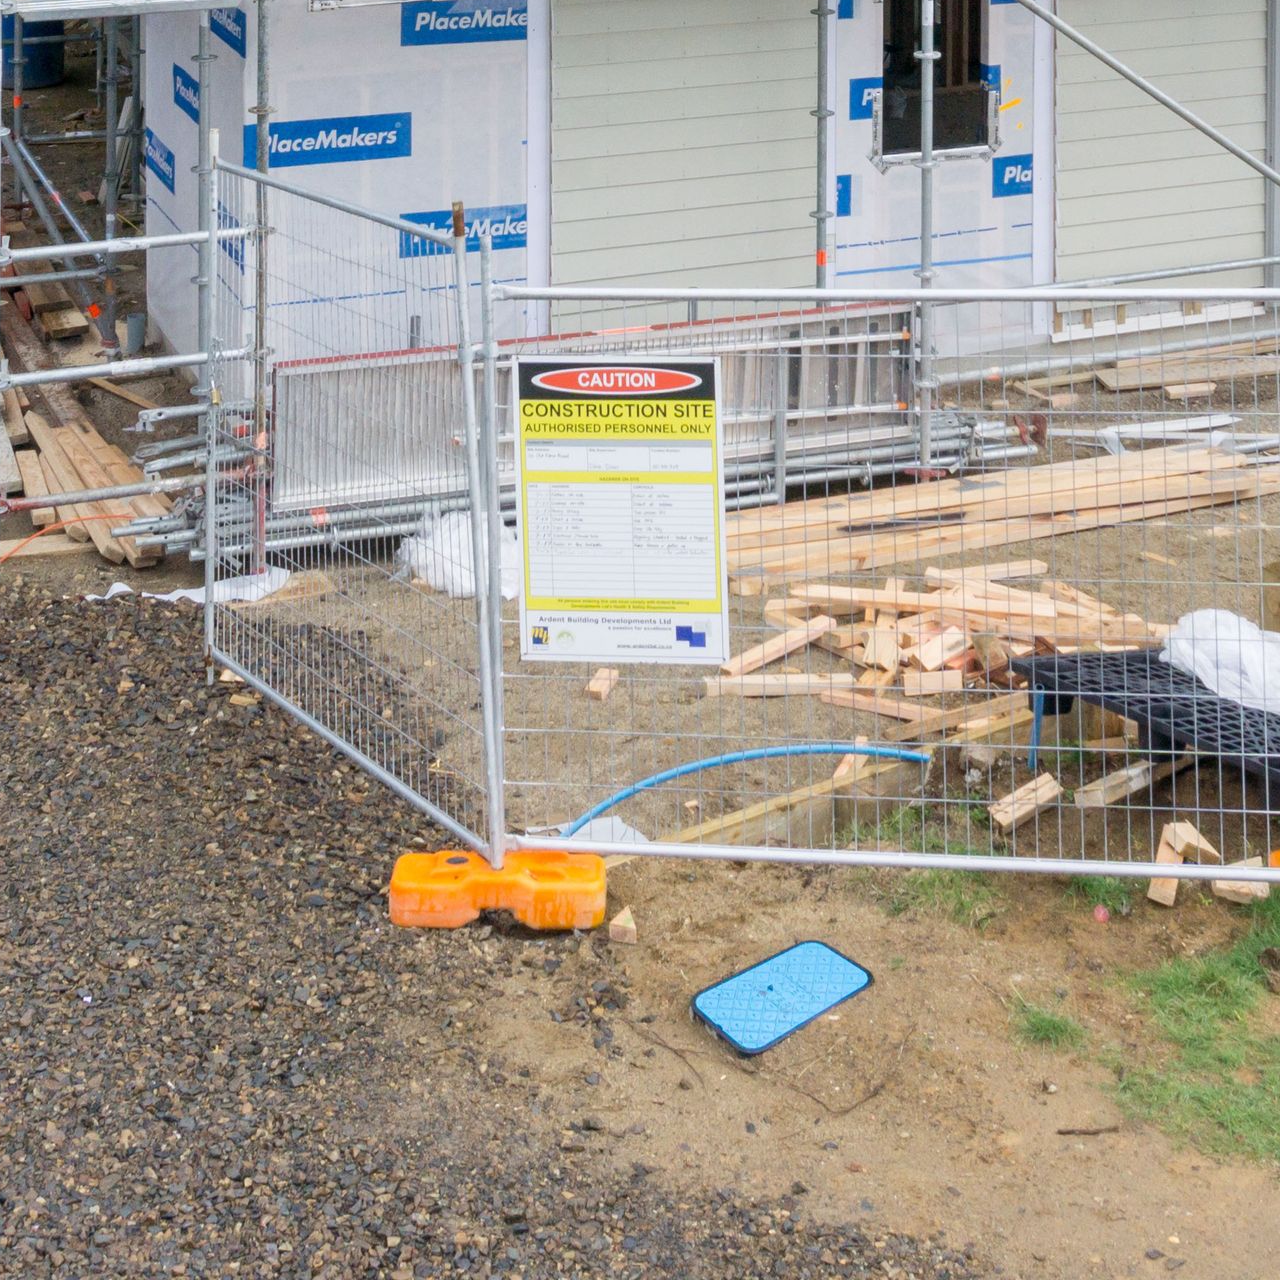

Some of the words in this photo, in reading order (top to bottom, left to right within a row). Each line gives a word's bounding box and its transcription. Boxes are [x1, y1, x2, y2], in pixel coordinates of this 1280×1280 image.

[577, 372, 656, 387] CAUTION
[522, 403, 667, 418] CONSTRUCTION
[673, 403, 714, 418] SITE
[525, 423, 601, 433] AUTHORISED
[604, 423, 677, 434] PERSONNEL
[680, 424, 712, 434] ONLY
[567, 616, 599, 625] Building
[601, 617, 657, 625] Developments
